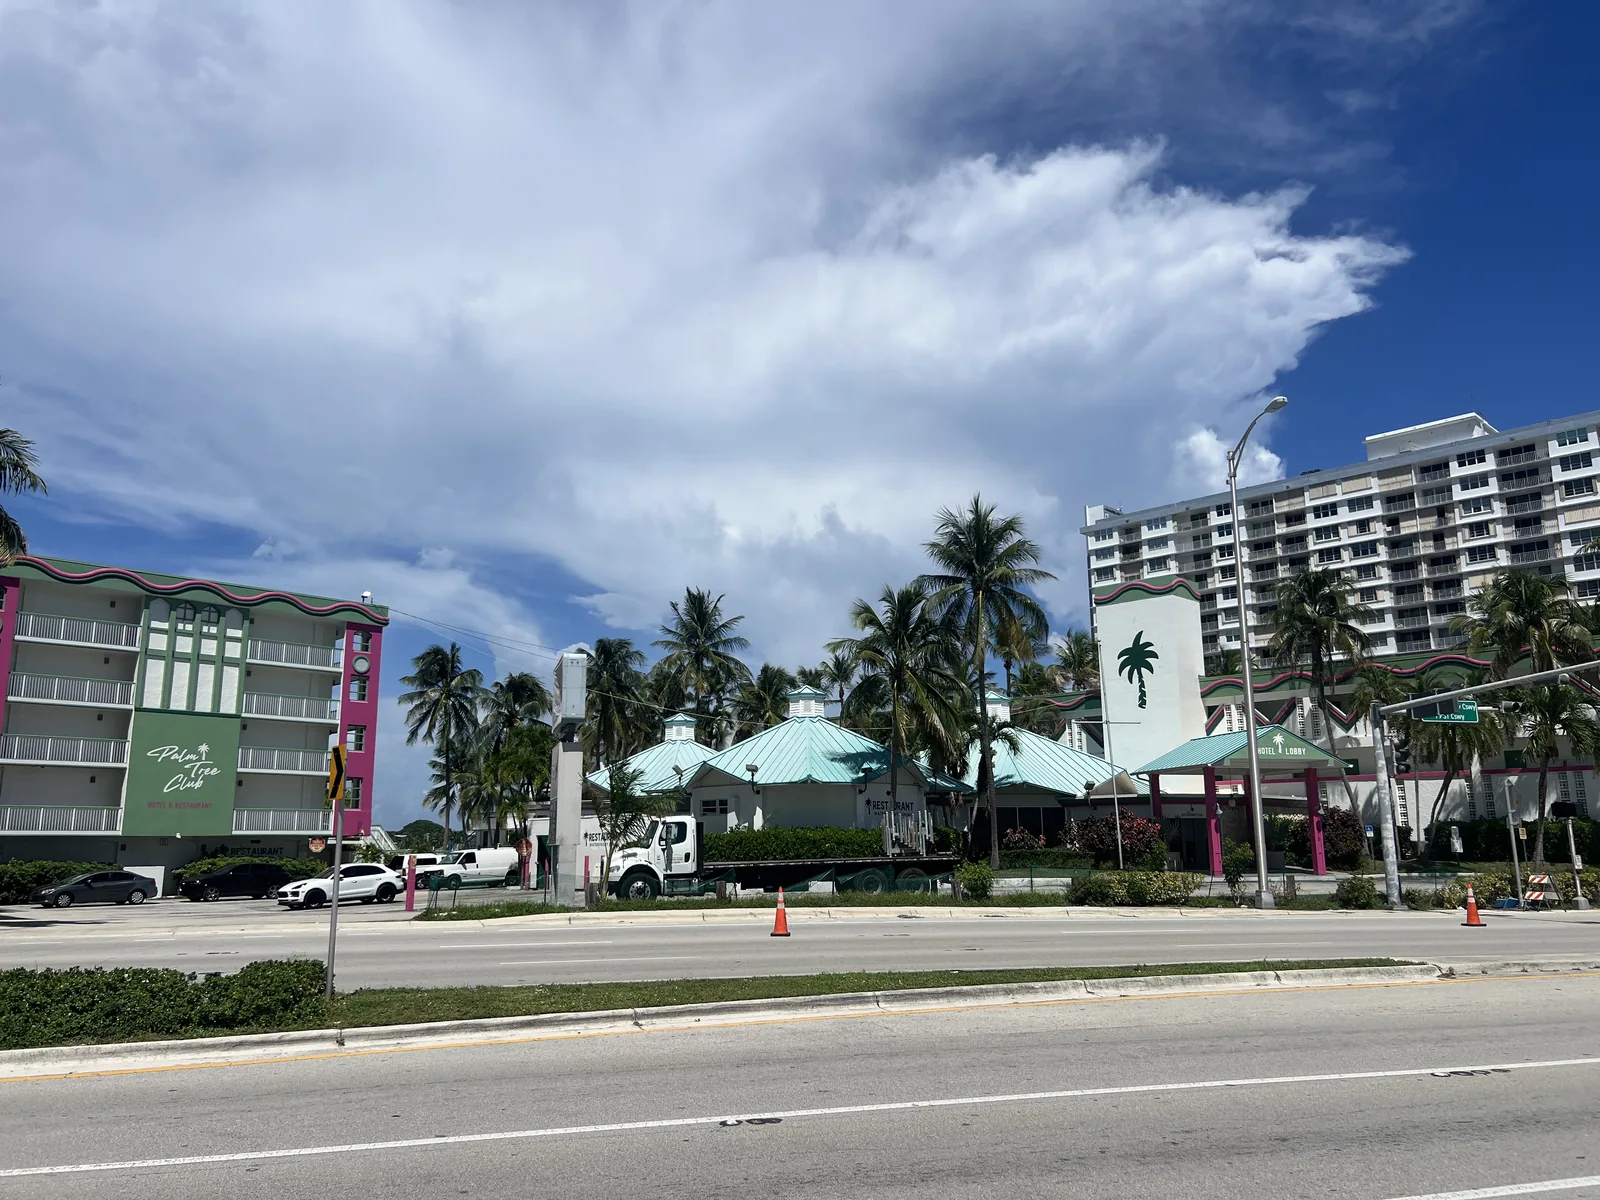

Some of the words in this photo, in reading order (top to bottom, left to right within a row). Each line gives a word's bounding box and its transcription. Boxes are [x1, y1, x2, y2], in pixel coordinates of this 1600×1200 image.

[146, 745, 199, 762] Palm
[1257, 747, 1276, 755] HOTEL
[1285, 747, 1306, 755] LOBBY
[184, 761, 221, 778] Tree
[163, 773, 204, 793] Club
[175, 802, 212, 810] RESTAURANT
[230, 847, 284, 856] RESTAURANT
